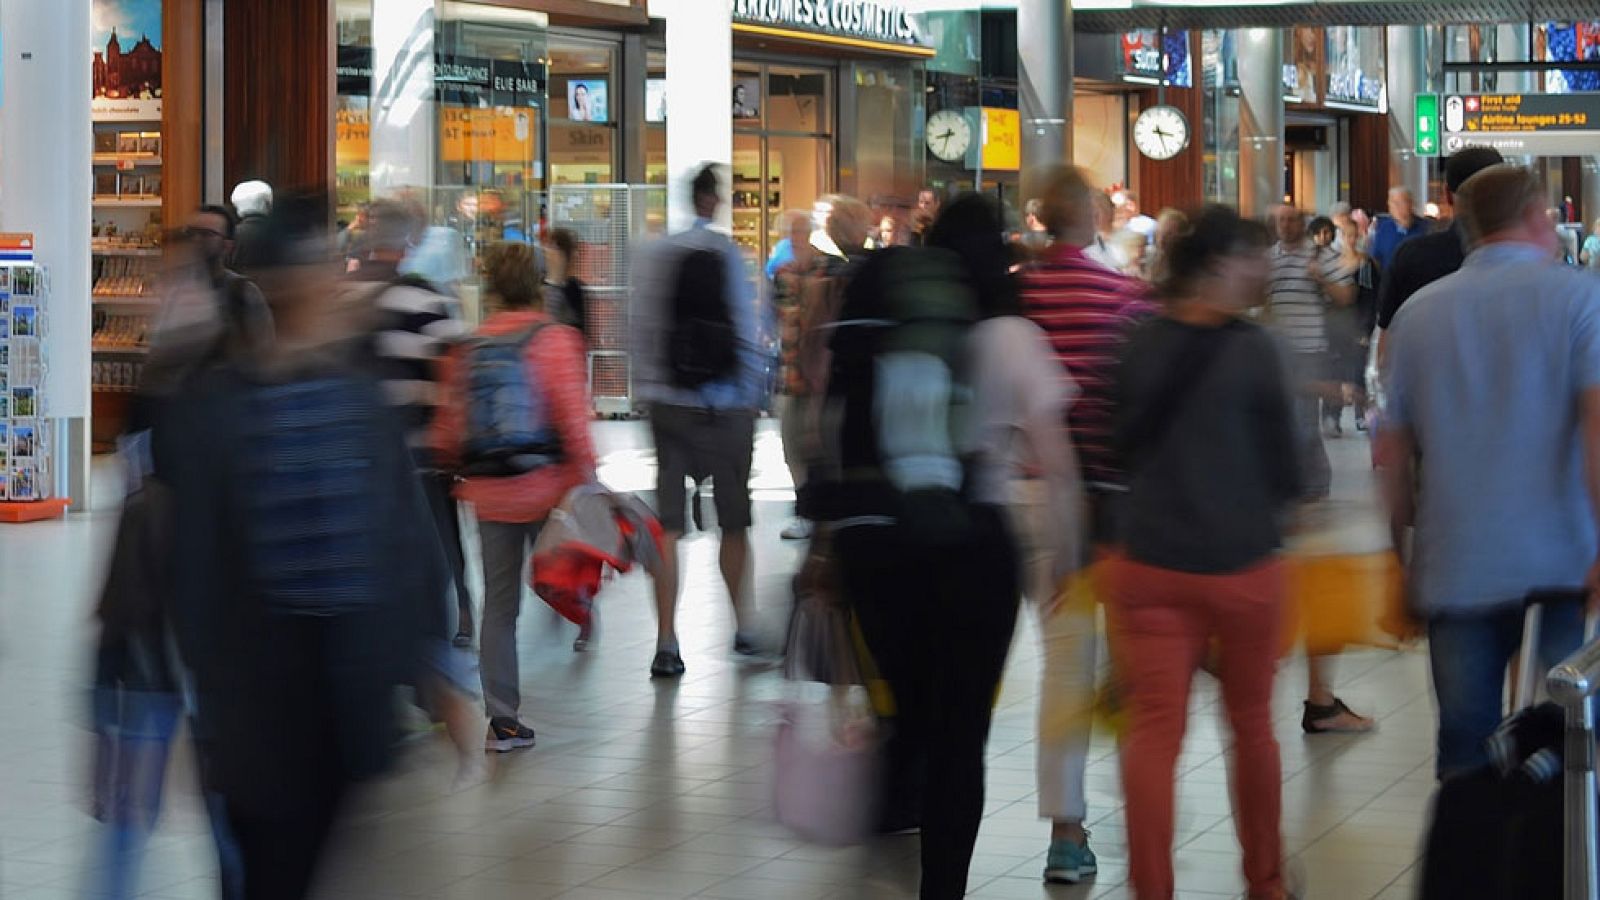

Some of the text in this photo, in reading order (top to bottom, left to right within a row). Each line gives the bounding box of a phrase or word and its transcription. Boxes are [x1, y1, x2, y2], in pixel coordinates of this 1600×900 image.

[735, 0, 912, 38] ERFUMES & COSMETICS
[494, 76, 514, 91] ELIE
[515, 77, 538, 93] SAAB
[1481, 95, 1521, 105] First aid
[1481, 114, 1515, 124] Airline
[1516, 113, 1557, 126] lounges
[569, 128, 605, 146] Skin
[1493, 139, 1524, 148] centre
